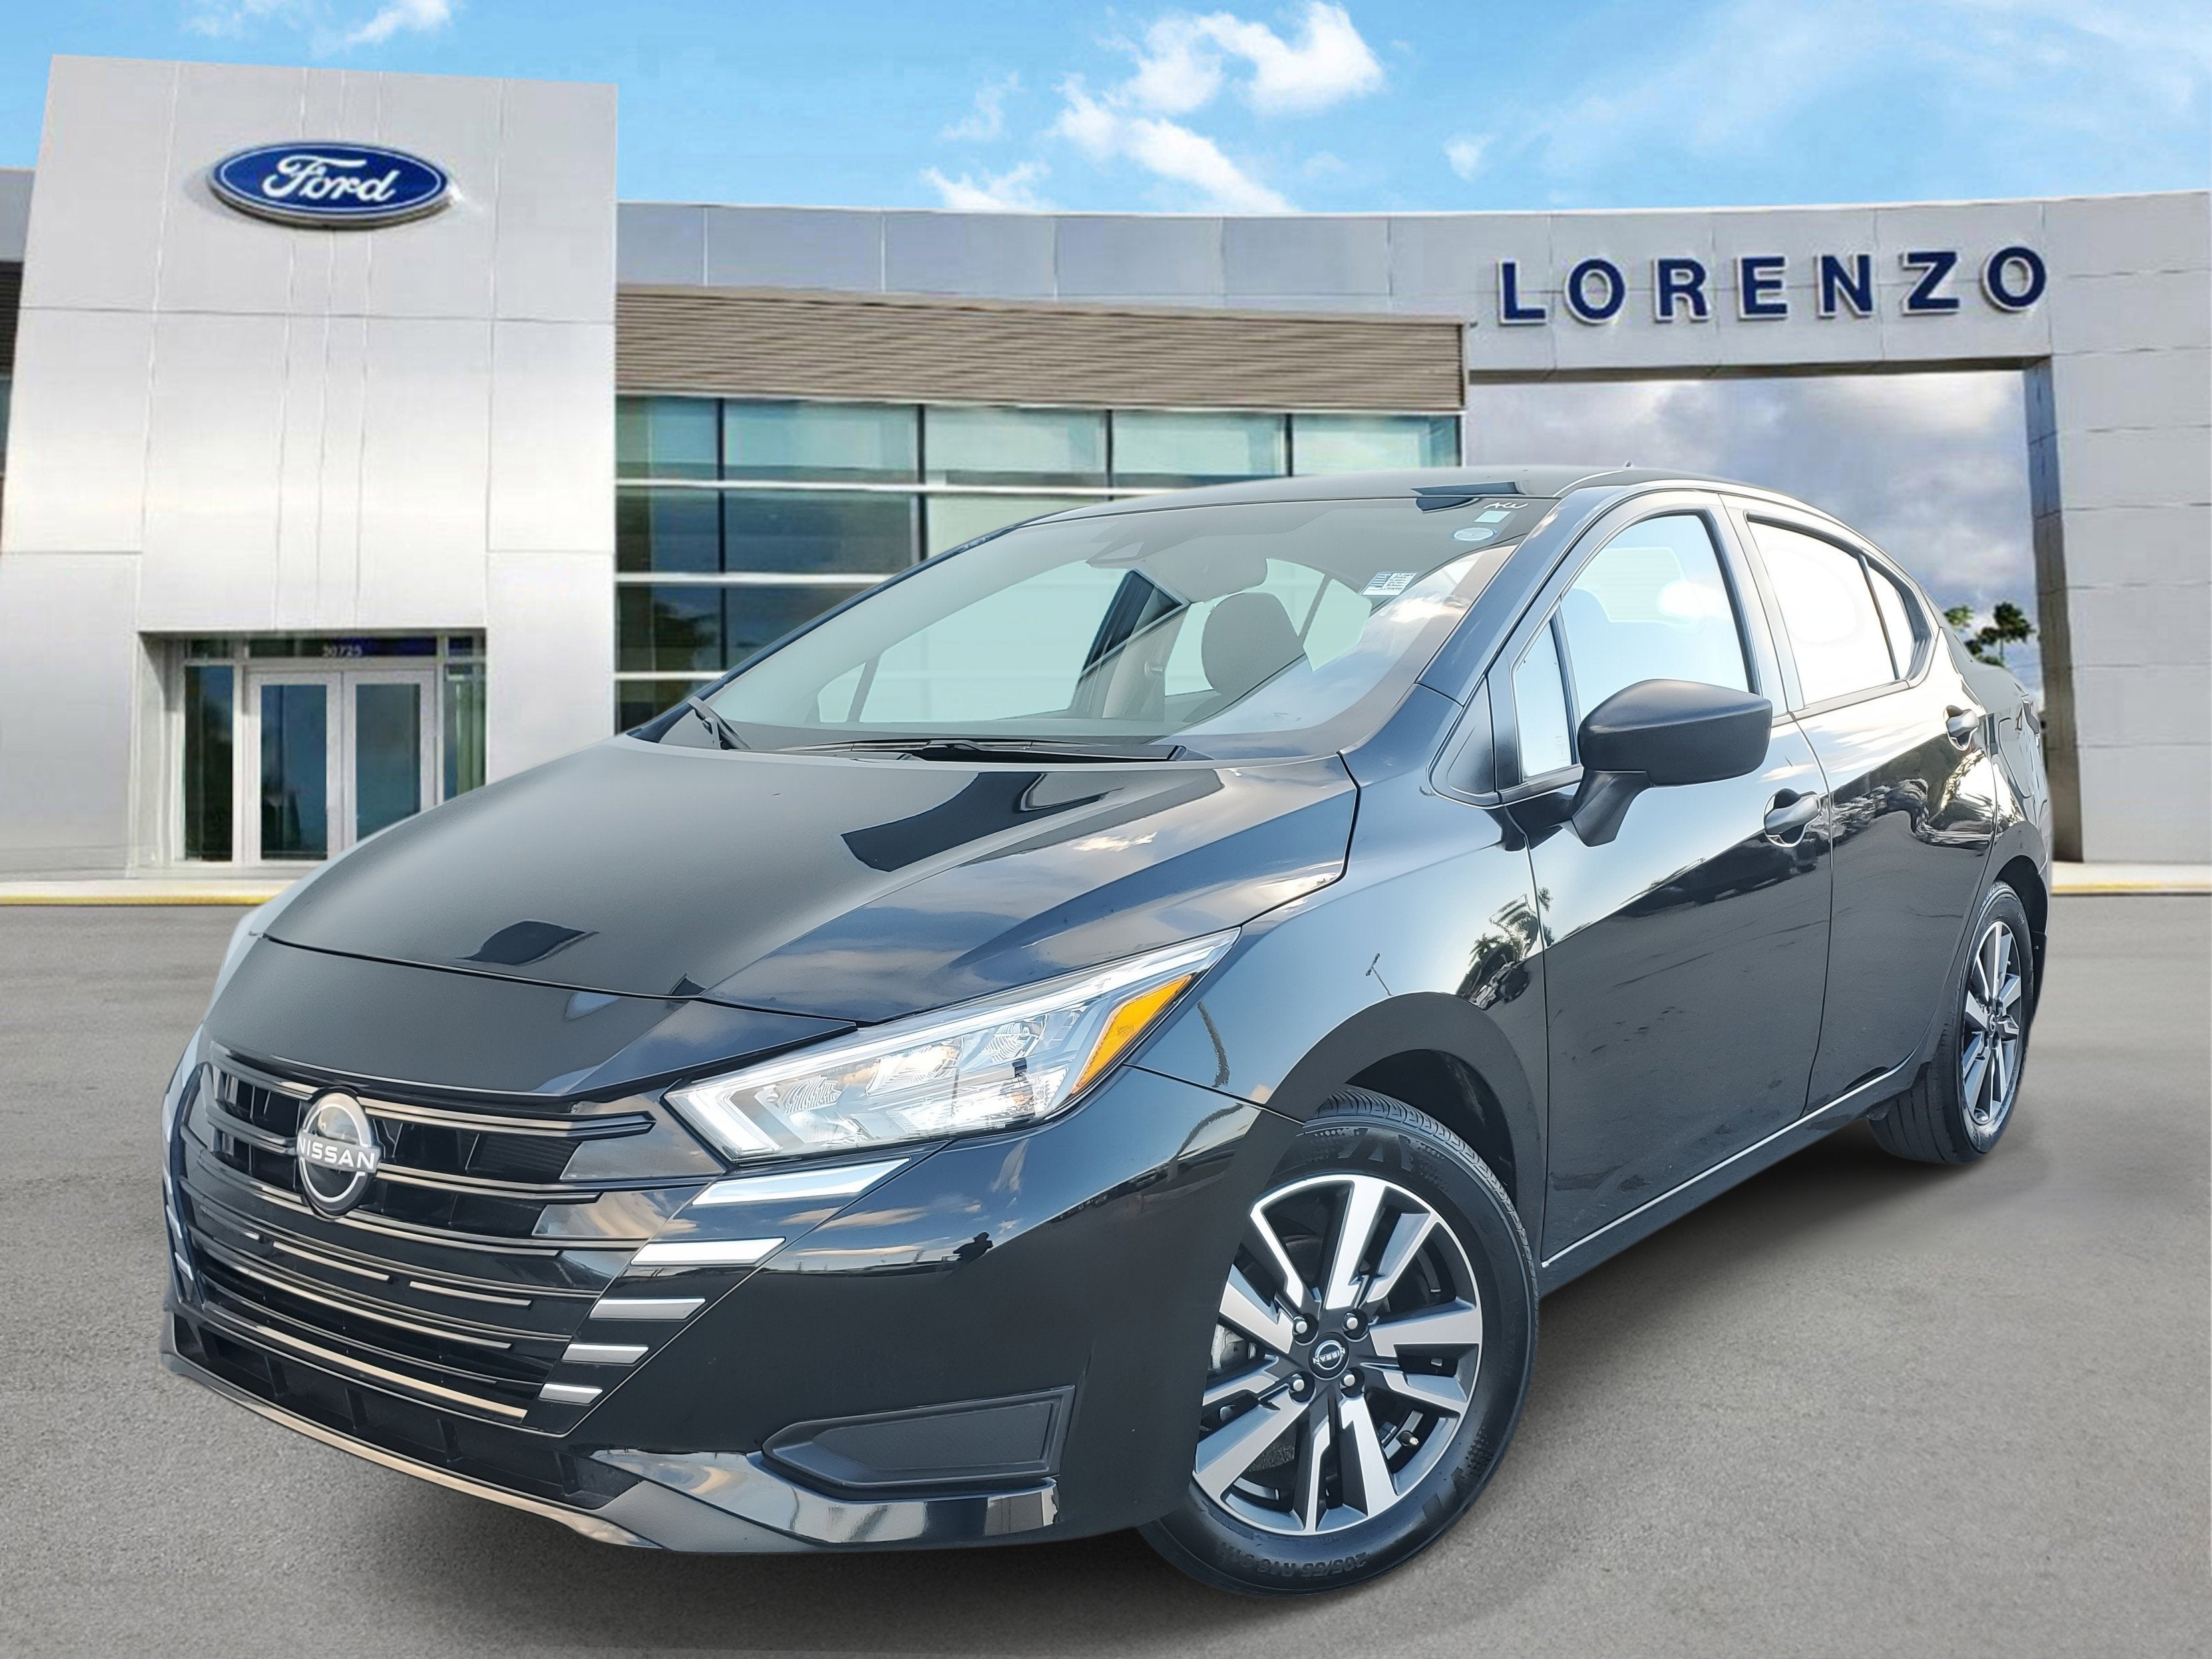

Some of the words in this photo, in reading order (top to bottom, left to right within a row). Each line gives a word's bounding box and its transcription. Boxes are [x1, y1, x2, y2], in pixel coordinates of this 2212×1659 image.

[262, 154, 400, 201] Ford
[1498, 246, 2047, 325] LORENZO
[299, 1137, 375, 1169] NISSAN
[1302, 1552, 1367, 1578] 205/55
